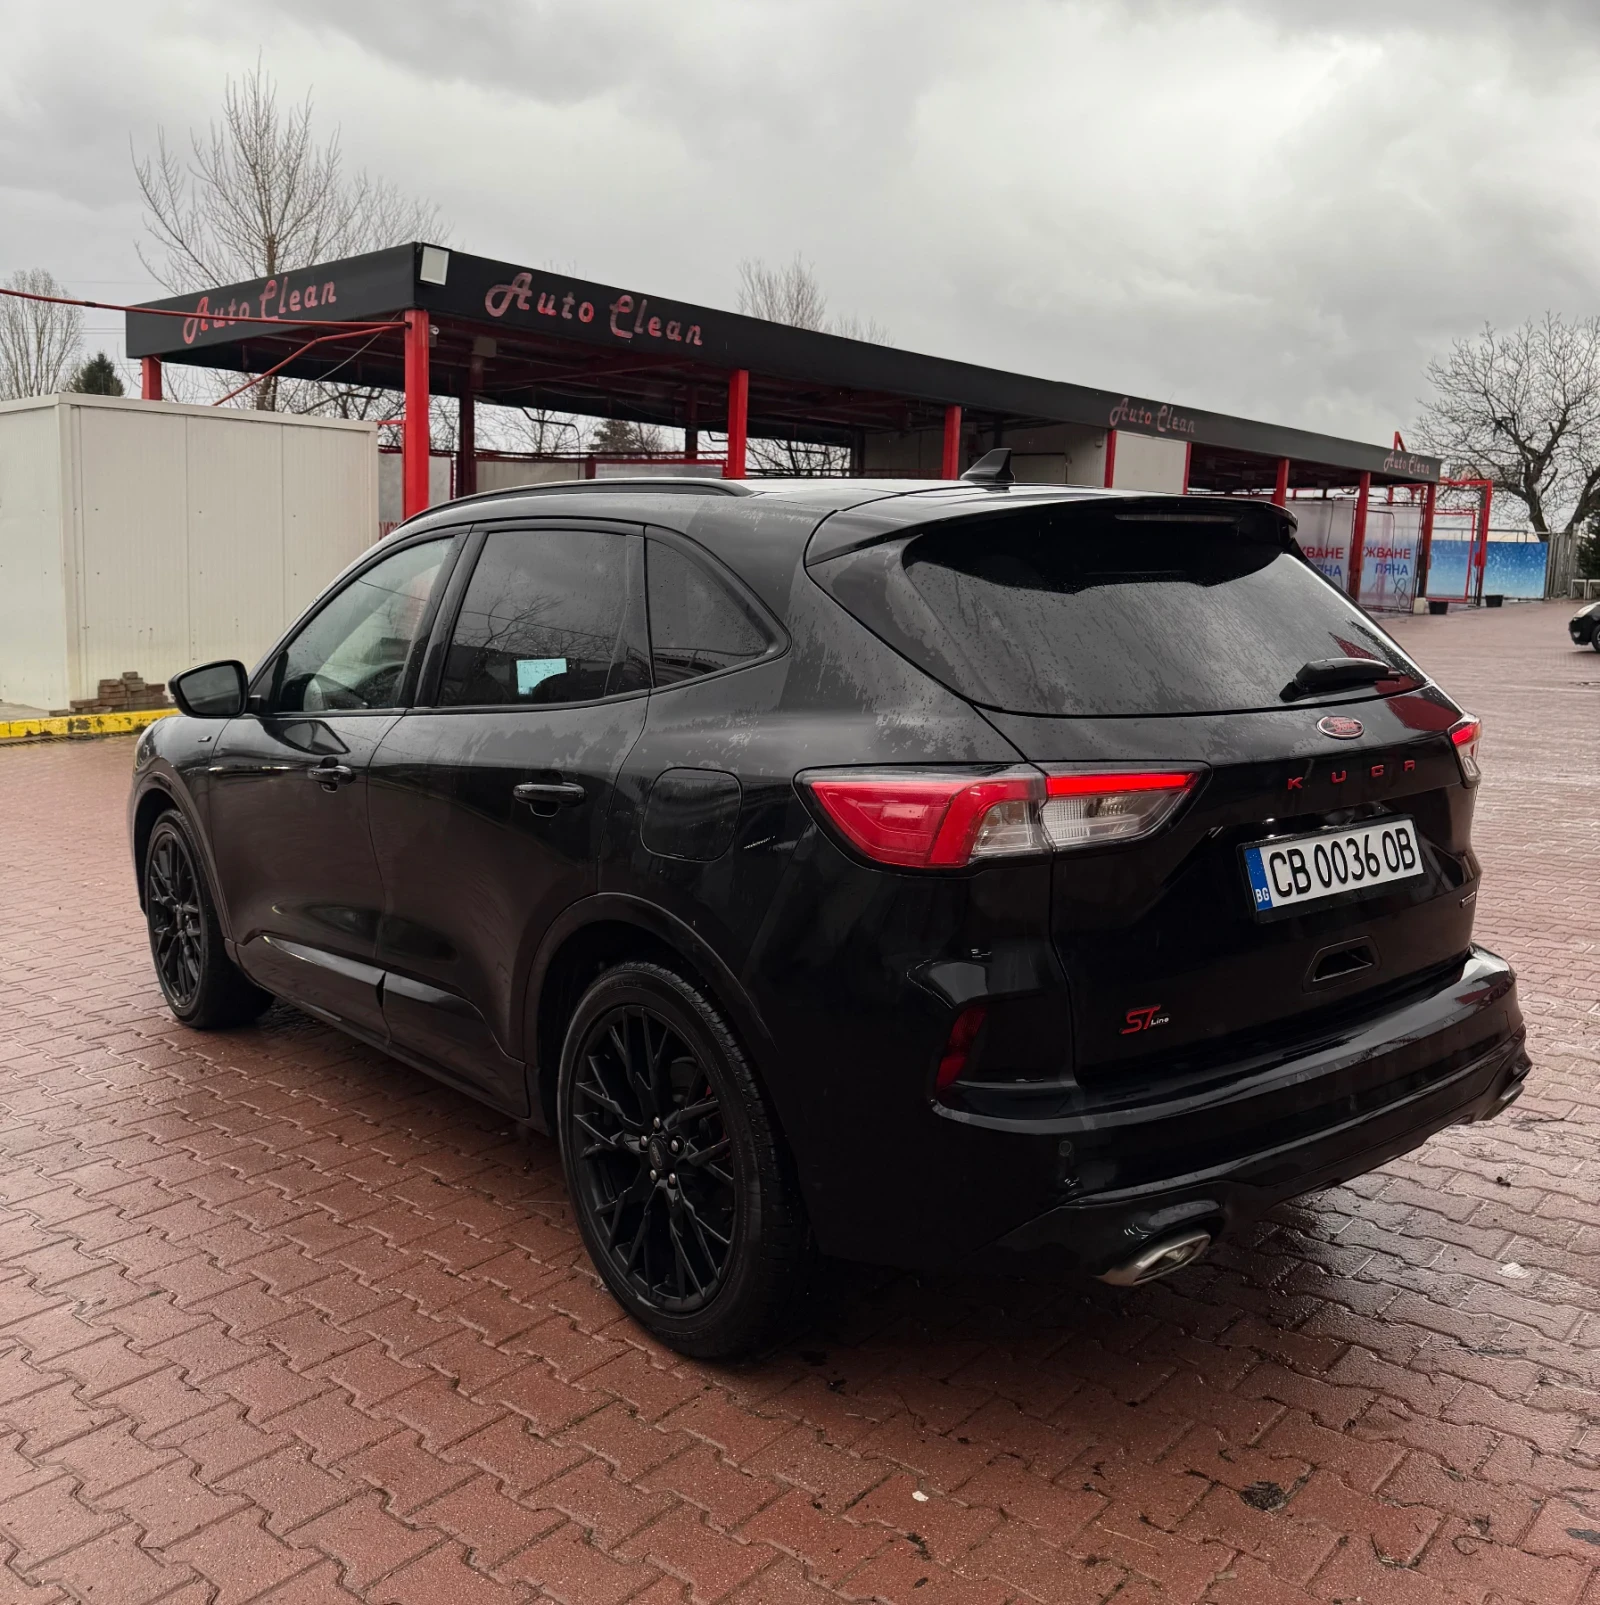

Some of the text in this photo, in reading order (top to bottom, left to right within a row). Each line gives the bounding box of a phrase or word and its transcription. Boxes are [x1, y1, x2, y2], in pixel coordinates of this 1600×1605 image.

[183, 276, 337, 345] Auto Clean
[484, 272, 703, 346] Auto Clean
[1109, 397, 1195, 433] Auto Clean
[1383, 451, 1430, 475] Auto Clean
[1302, 546, 1344, 560] ВАНЕ
[1362, 546, 1411, 560] ЖВАНЕ
[1375, 563, 1409, 576] ПЯНА
[1287, 760, 1416, 790] KUGA
[1313, 834, 1381, 889] 0036
[1255, 888, 1270, 903] BG
[1120, 1005, 1161, 1035] ST
